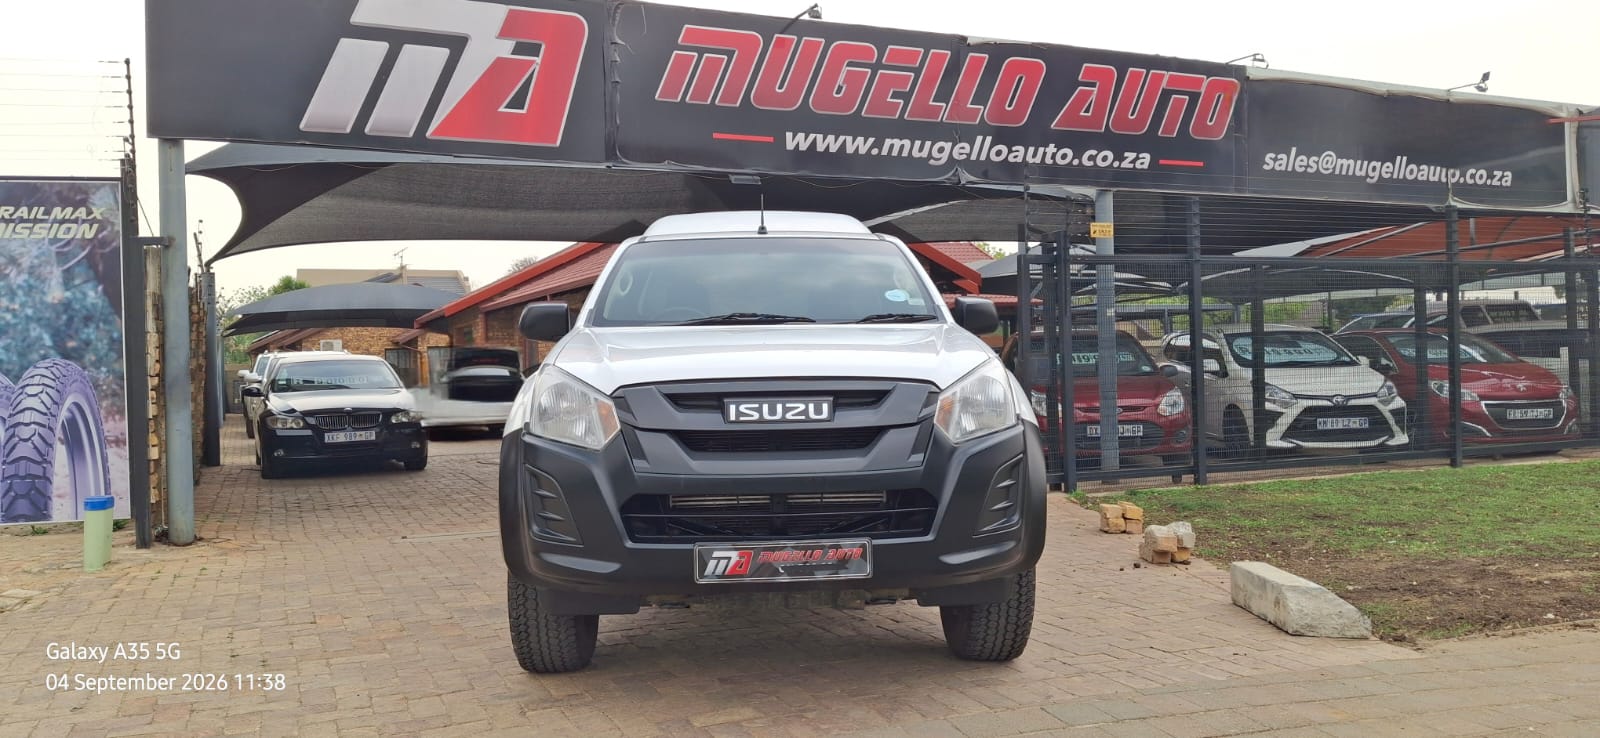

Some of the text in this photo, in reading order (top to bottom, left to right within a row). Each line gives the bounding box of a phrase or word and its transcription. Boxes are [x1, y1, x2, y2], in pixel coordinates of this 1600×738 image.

[655, 24, 1241, 141] MUGELLO AUTO
[785, 131, 1151, 170] www.mugelloauto.co.za
[729, 403, 828, 421] ISUZU
[824, 548, 863, 561] AUTO
